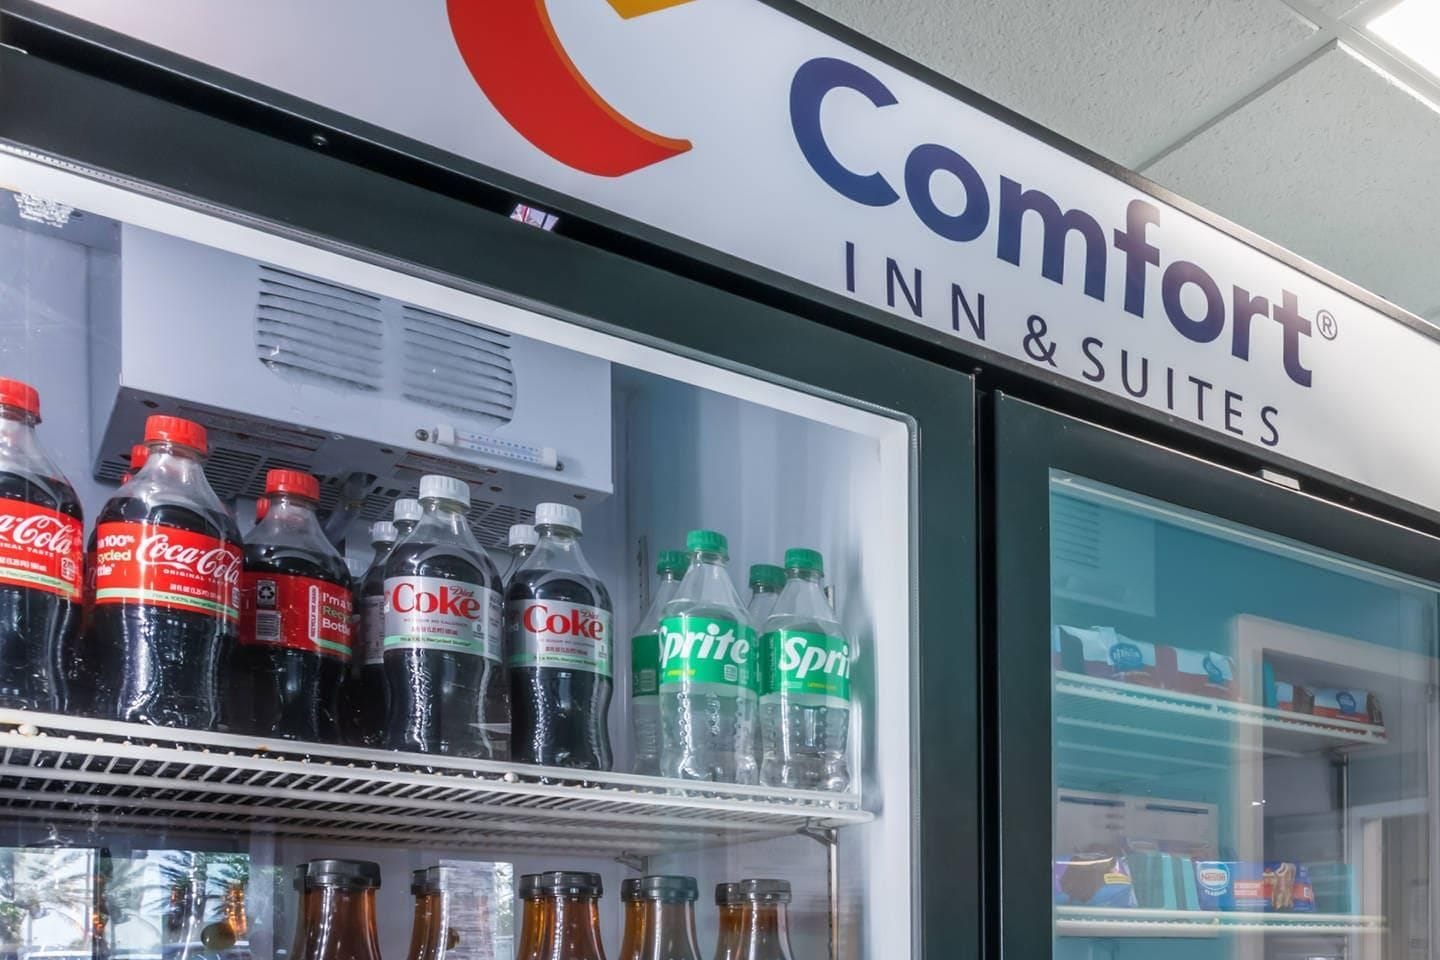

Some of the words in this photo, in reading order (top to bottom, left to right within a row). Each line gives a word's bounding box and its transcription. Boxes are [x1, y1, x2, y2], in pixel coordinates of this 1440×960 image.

[788, 56, 1313, 388] Comfort
[844, 240, 989, 341] INN
[1022, 313, 1058, 368] &
[1081, 337, 1281, 449] SUITES
[0, 514, 76, 555] a-Cola
[98, 550, 132, 563] ycled
[322, 606, 348, 623] Recy
[392, 583, 481, 619] Coke
[523, 605, 603, 640] Coke
[778, 637, 849, 679] Spri
